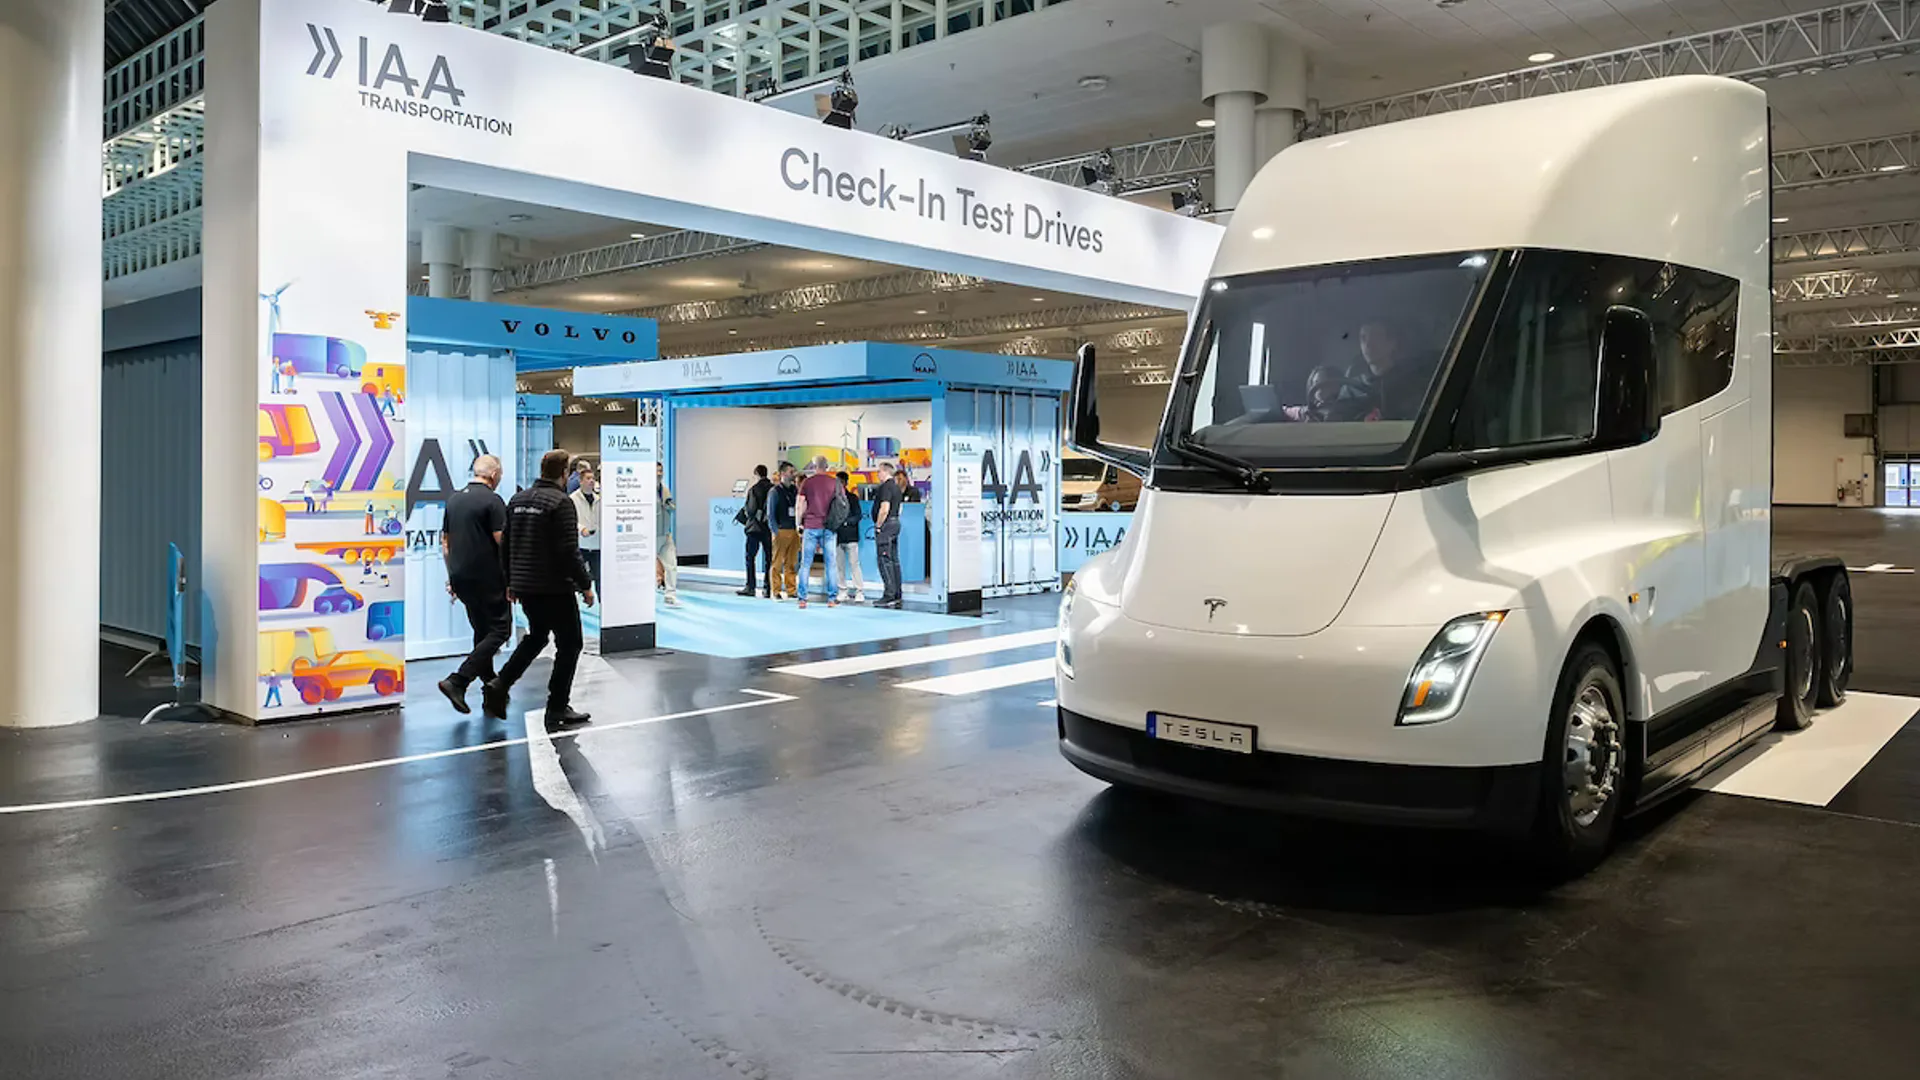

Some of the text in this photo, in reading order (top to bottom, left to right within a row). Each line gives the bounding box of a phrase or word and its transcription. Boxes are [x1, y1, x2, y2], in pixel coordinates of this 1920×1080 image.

[358, 36, 466, 107] IAA
[358, 91, 513, 137] TRANSPORTATION
[780, 147, 1104, 254] Check-In Test Drives
[501, 319, 636, 344] VOLVO
[1015, 361, 1038, 377] IAA
[617, 435, 639, 448] IAA
[982, 450, 1043, 505] AA
[981, 509, 1044, 523] NSPORTATION
[1163, 722, 1243, 745] TESLA
